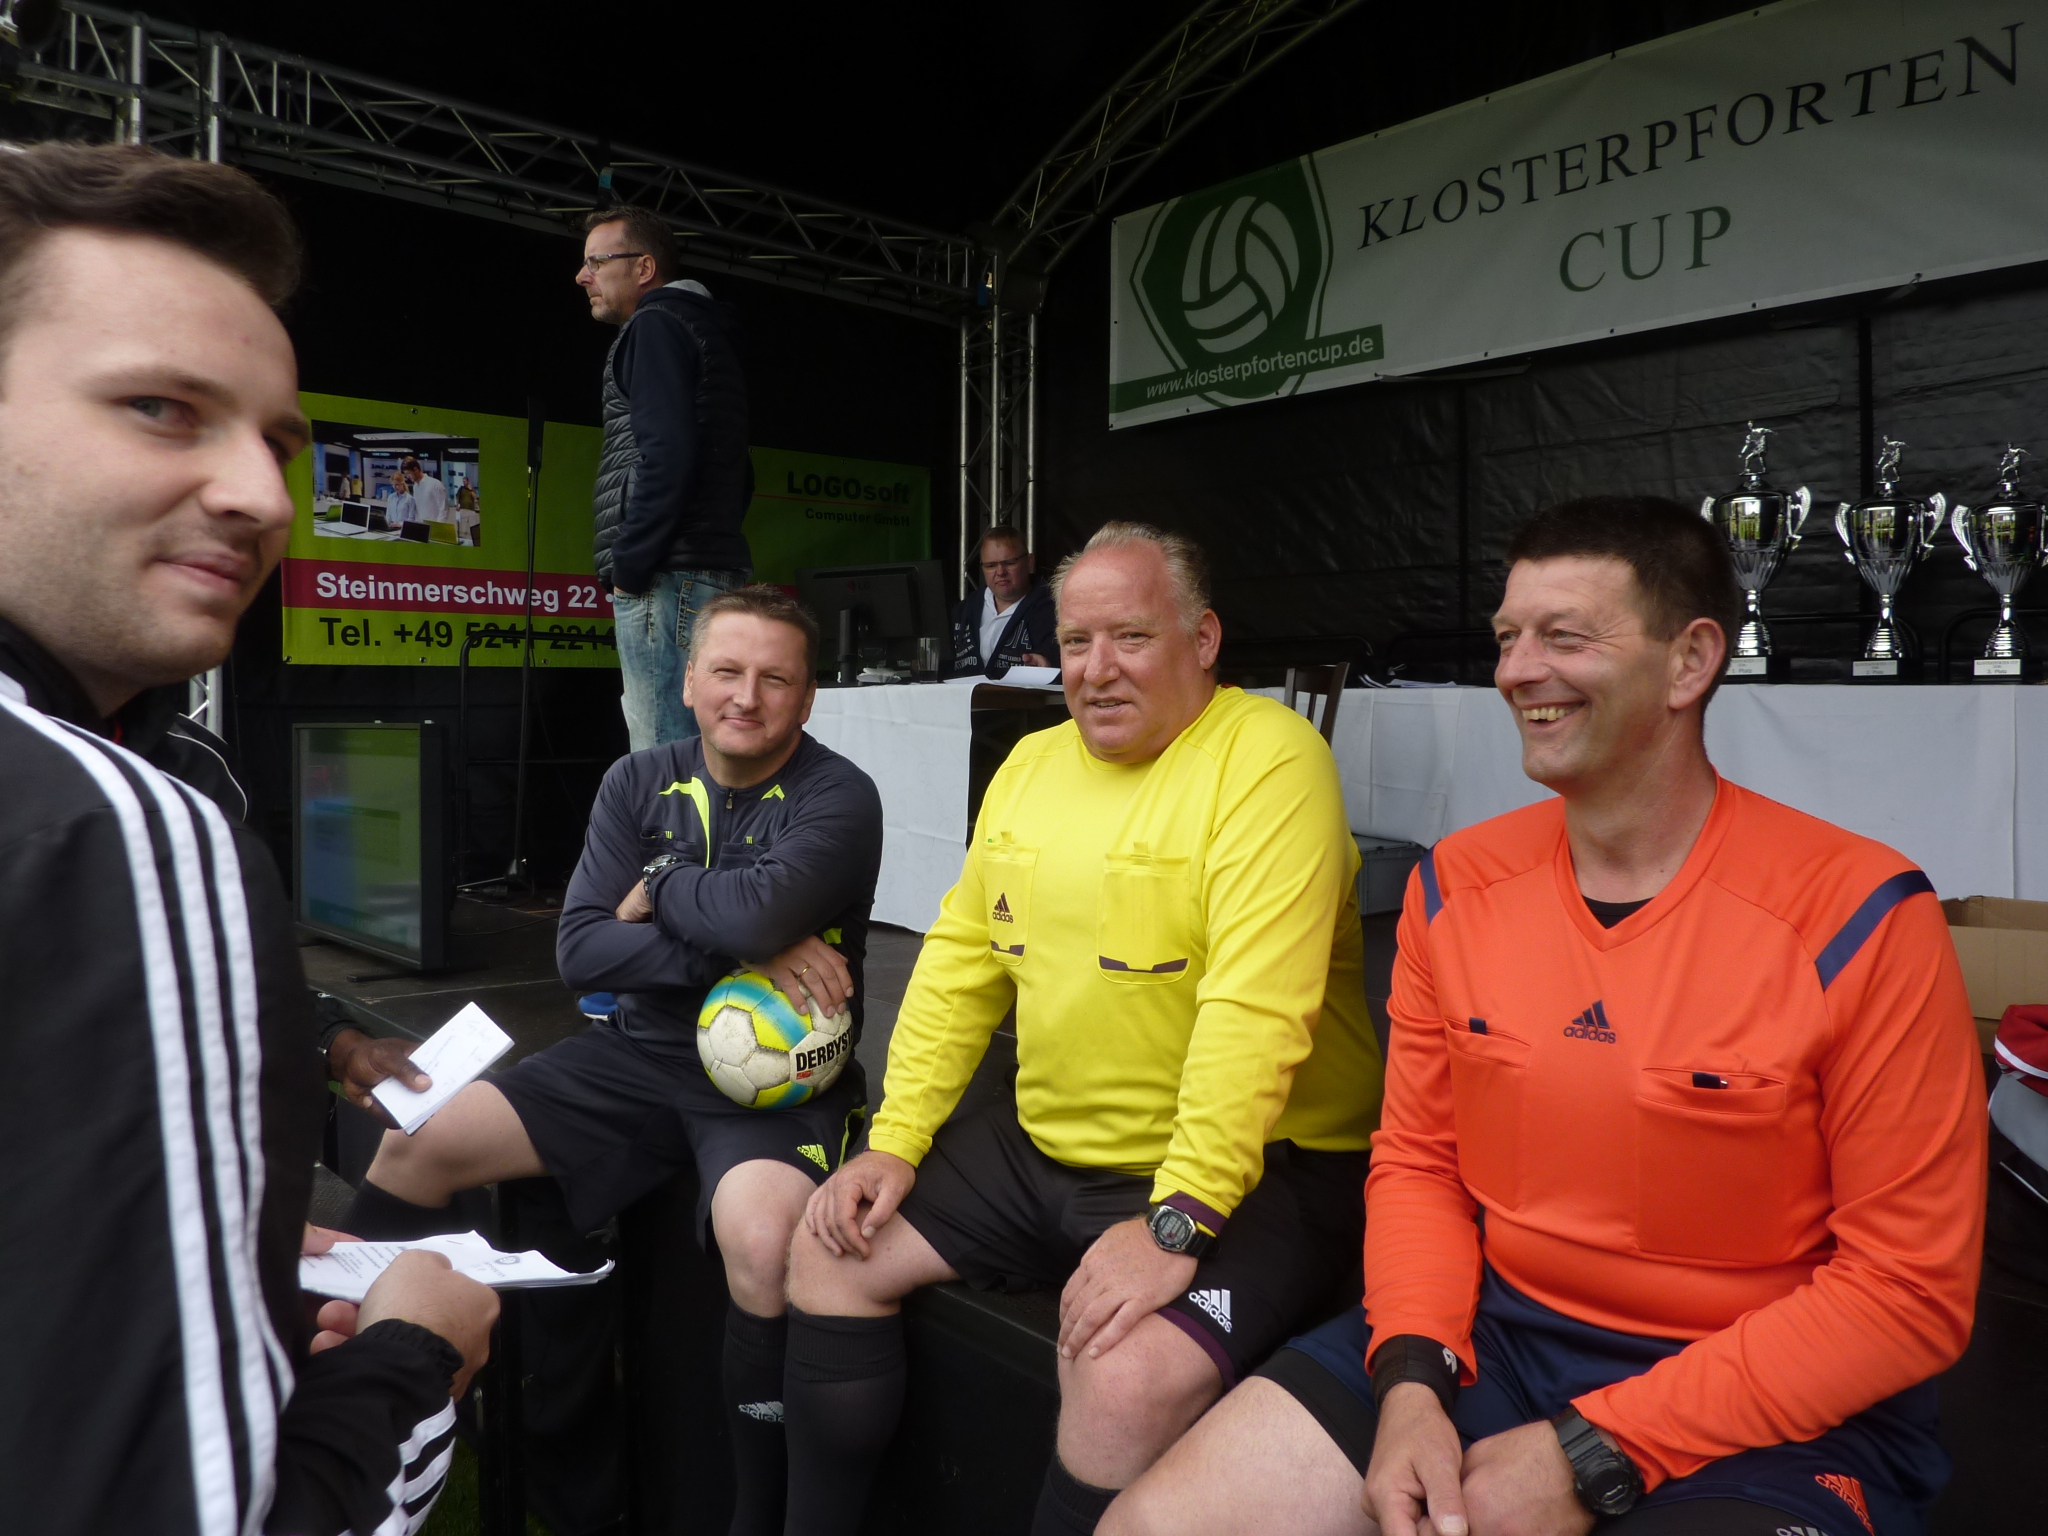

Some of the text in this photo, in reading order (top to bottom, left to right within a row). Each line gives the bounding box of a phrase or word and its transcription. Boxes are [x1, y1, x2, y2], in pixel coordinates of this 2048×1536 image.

[1357, 21, 2026, 251] KLOSTERPFORTEN
[1559, 205, 1732, 293] CUP
[1145, 334, 1375, 399] www.klosterpfortencup.de
[787, 470, 911, 505] LOGOsoft
[805, 507, 911, 528] Computer GmbH
[316, 571, 598, 613] Steinmerschweg 22
[319, 617, 382, 647] Tel.
[393, 620, 454, 648] +49
[992, 911, 1014, 924] adidas
[1563, 1025, 1617, 1045] adidas
[796, 1146, 829, 1173] adidas
[1188, 1291, 1233, 1334] adidas
